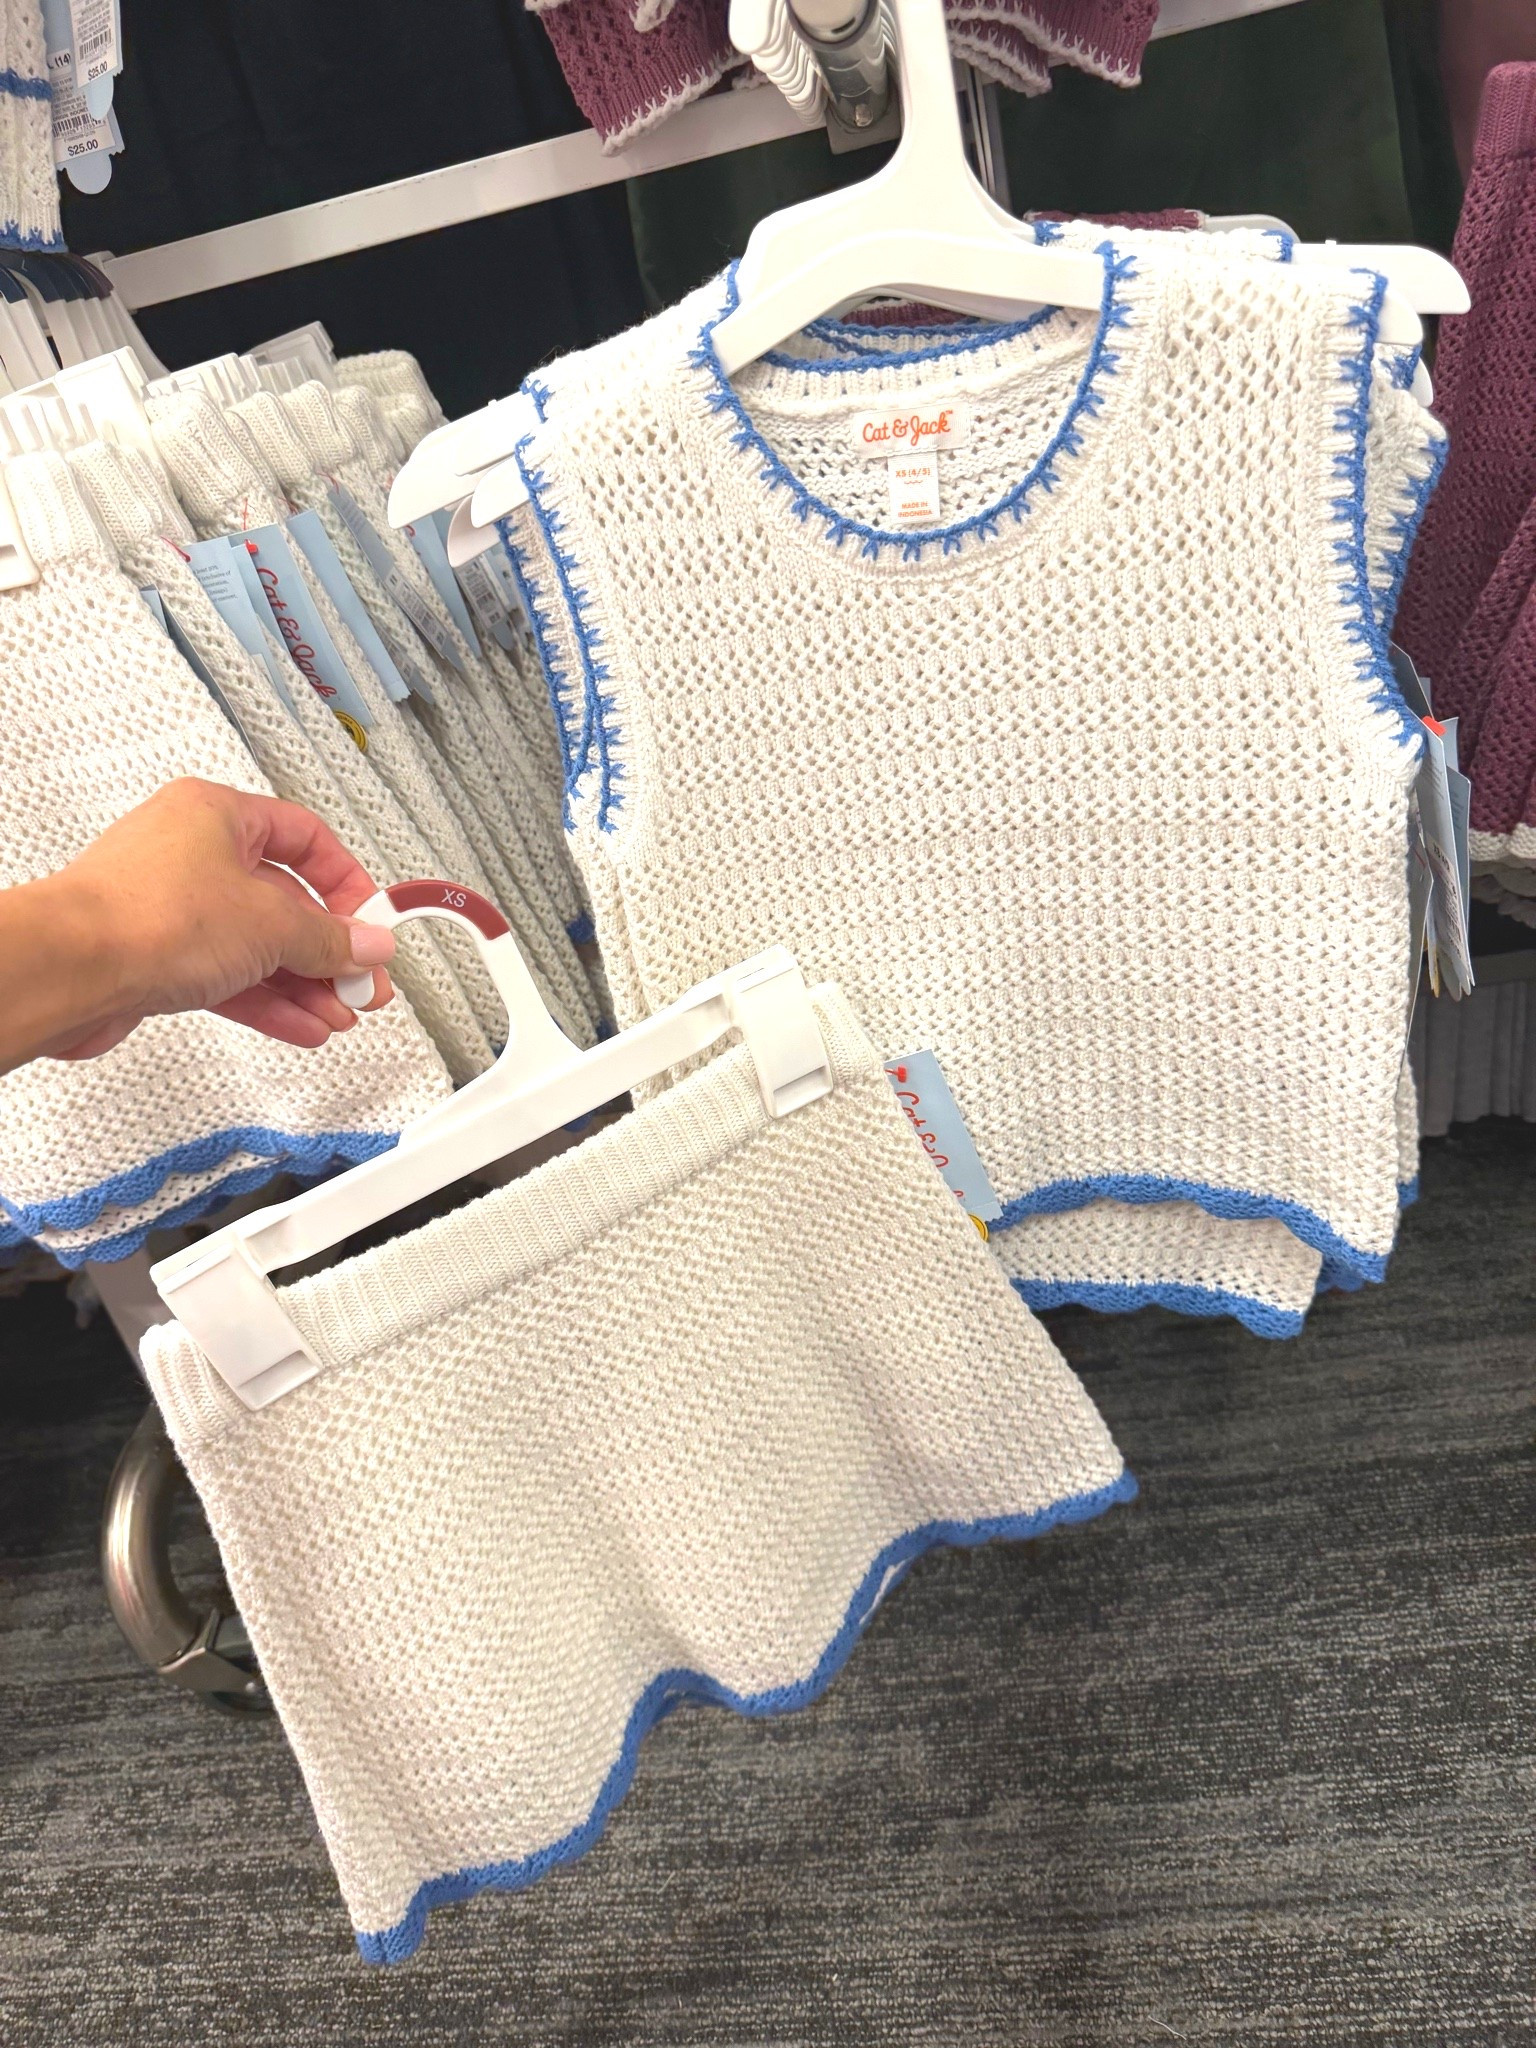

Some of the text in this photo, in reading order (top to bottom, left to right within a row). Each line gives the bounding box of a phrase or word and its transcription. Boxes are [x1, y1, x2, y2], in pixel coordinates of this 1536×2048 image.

[55, 53, 71, 67] (14)
[88, 61, 108, 80] $25.00
[68, 139, 98, 157] $25.00
[863, 423, 890, 442] Cat
[893, 419, 908, 438] &
[441, 889, 466, 907] XS
